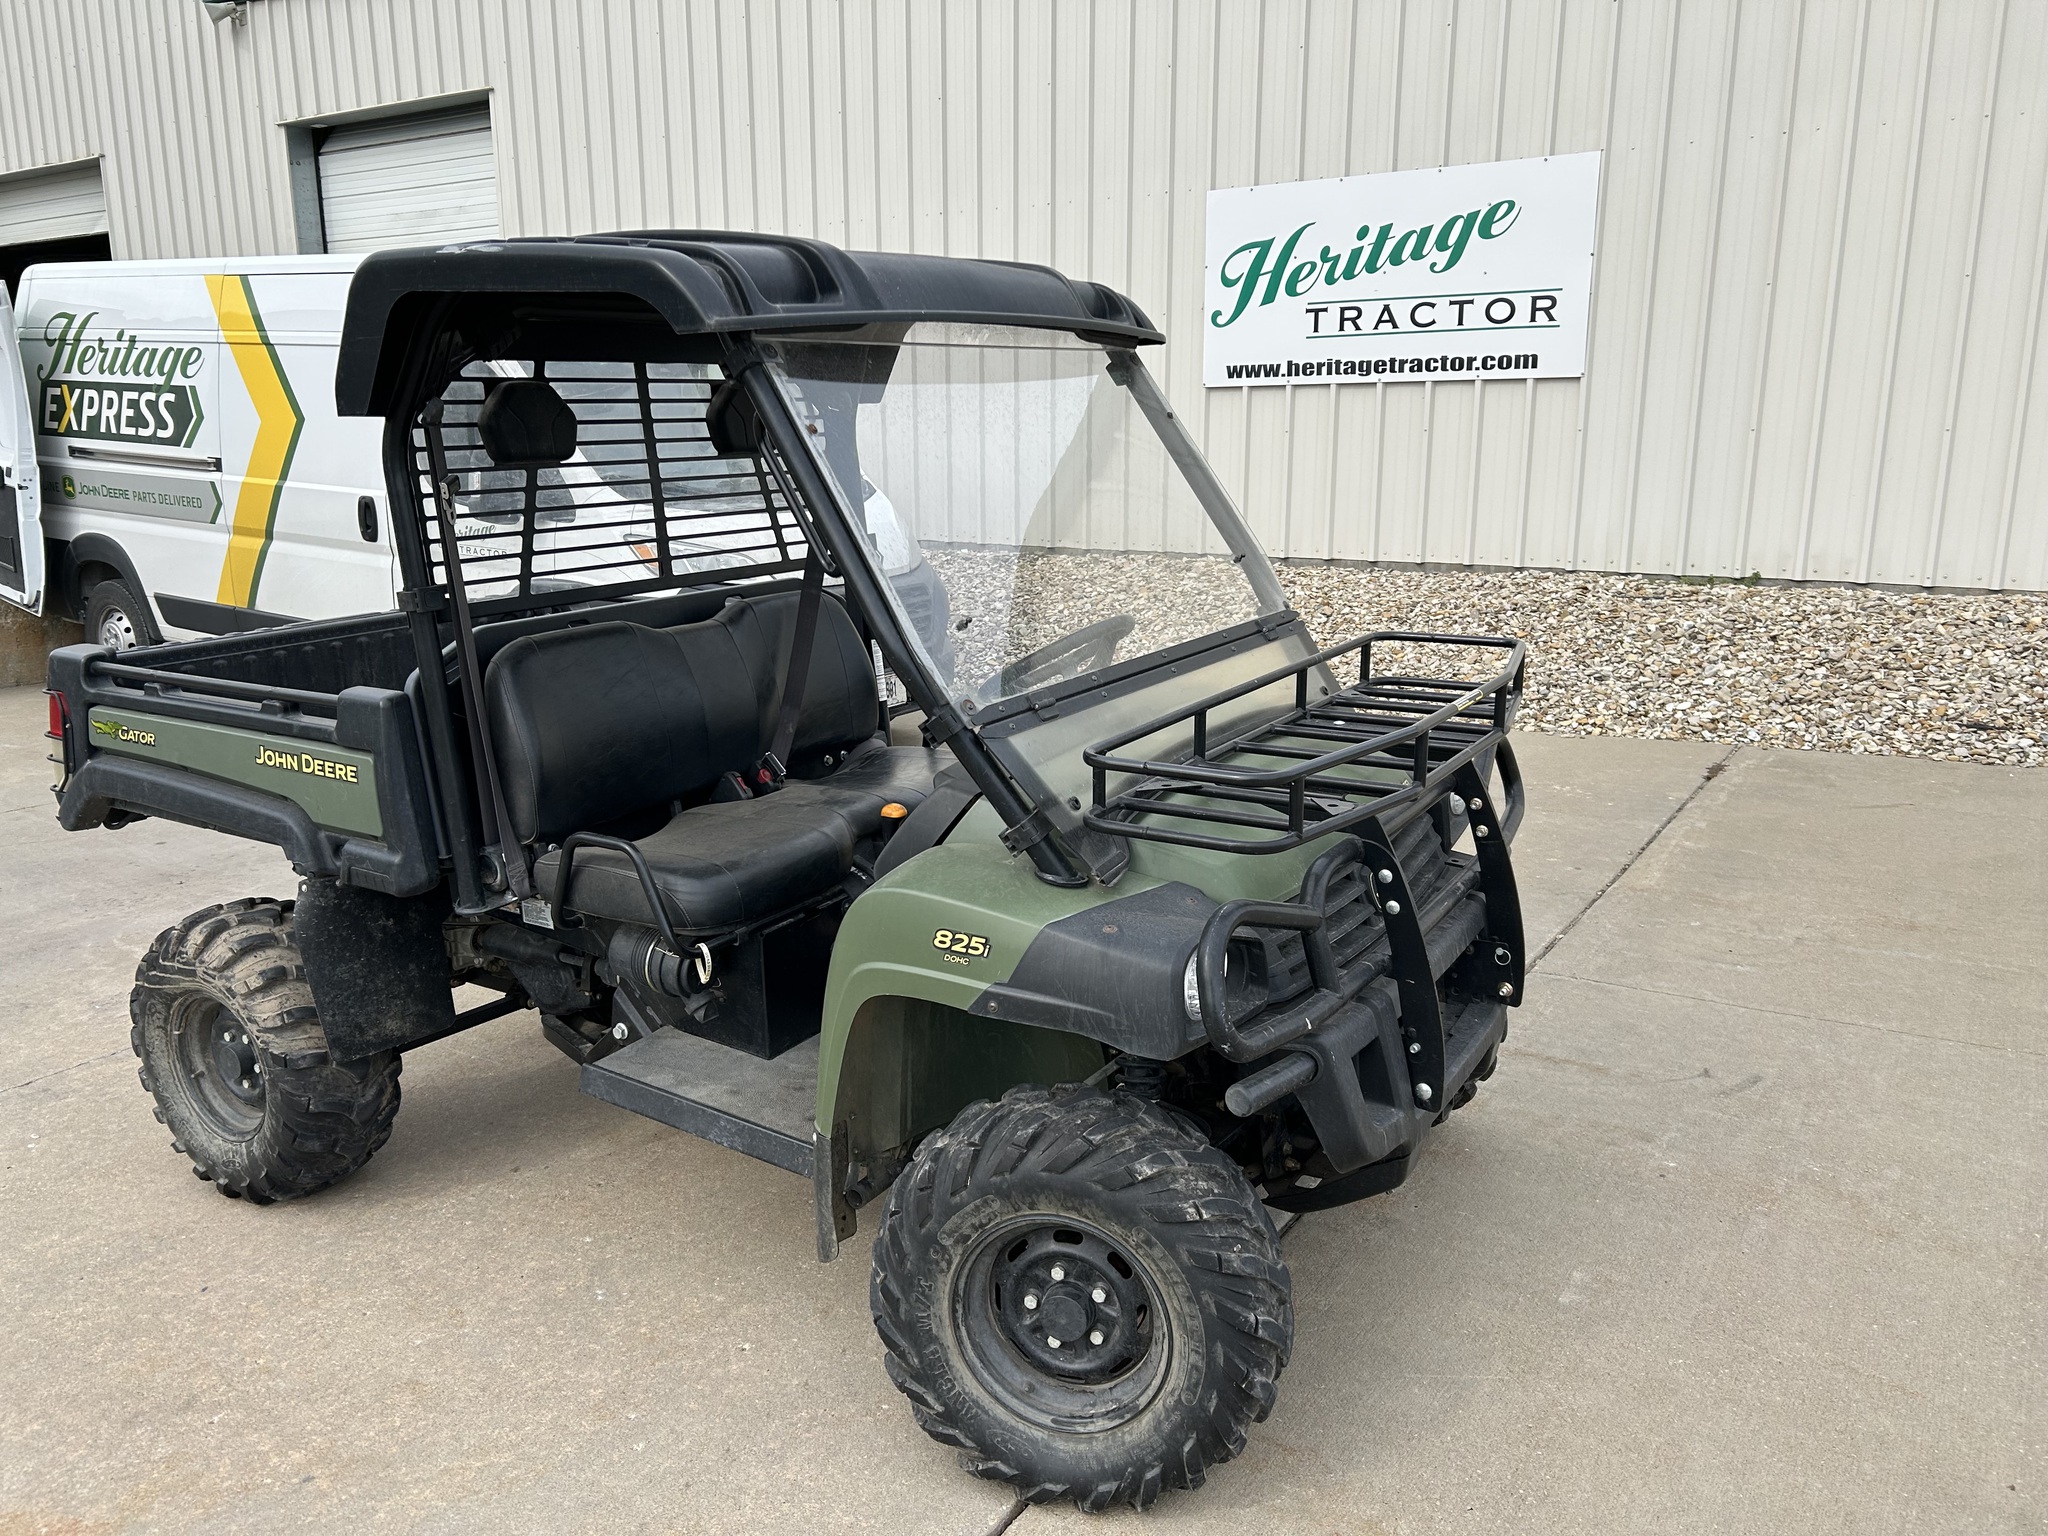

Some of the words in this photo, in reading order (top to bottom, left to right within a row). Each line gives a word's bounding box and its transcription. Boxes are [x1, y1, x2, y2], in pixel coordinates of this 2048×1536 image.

[1211, 199, 1522, 328] Heritage
[1306, 295, 1558, 333] TRACTOR
[37, 311, 205, 395] Heritage
[1226, 354, 1538, 379] www.heritagetractor.com
[44, 384, 176, 438] EXPRESS
[78, 482, 101, 496] JOHN
[101, 484, 130, 500] DEERE
[132, 490, 157, 504] PARTS
[158, 493, 203, 509] DELIVERED
[118, 725, 156, 747] GATOR
[255, 745, 299, 772] JOHN
[301, 753, 358, 784] DEERE
[933, 928, 991, 958] 825i
[943, 953, 969, 965] DOHC
